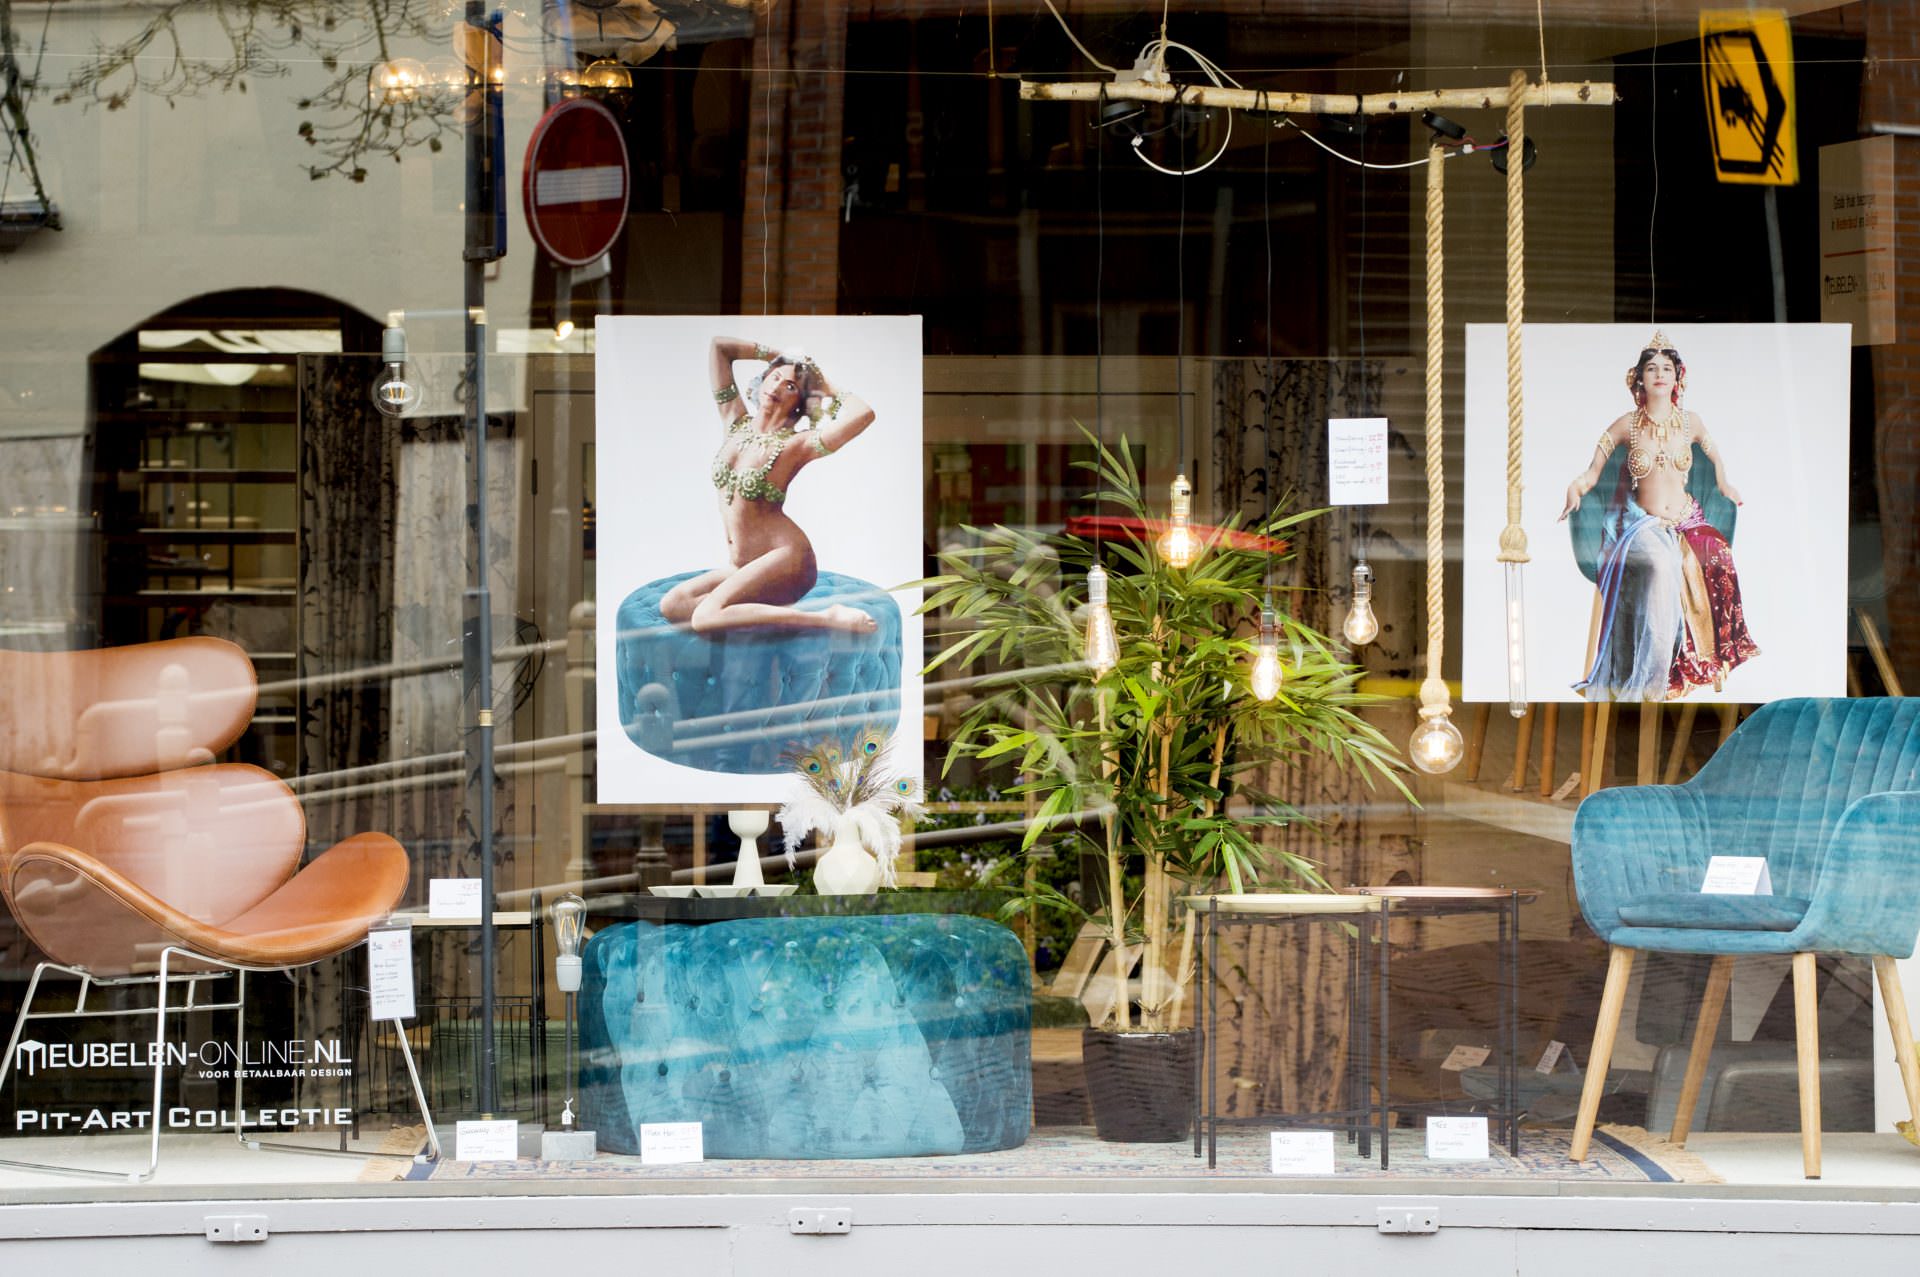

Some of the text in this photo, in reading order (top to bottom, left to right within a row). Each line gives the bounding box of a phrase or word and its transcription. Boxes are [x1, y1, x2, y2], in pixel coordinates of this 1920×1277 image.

[16, 1039, 352, 1076] MEUBELEN-ONLINE.NL
[199, 1068, 352, 1079] VOOR BETAALBAAR DESIGN
